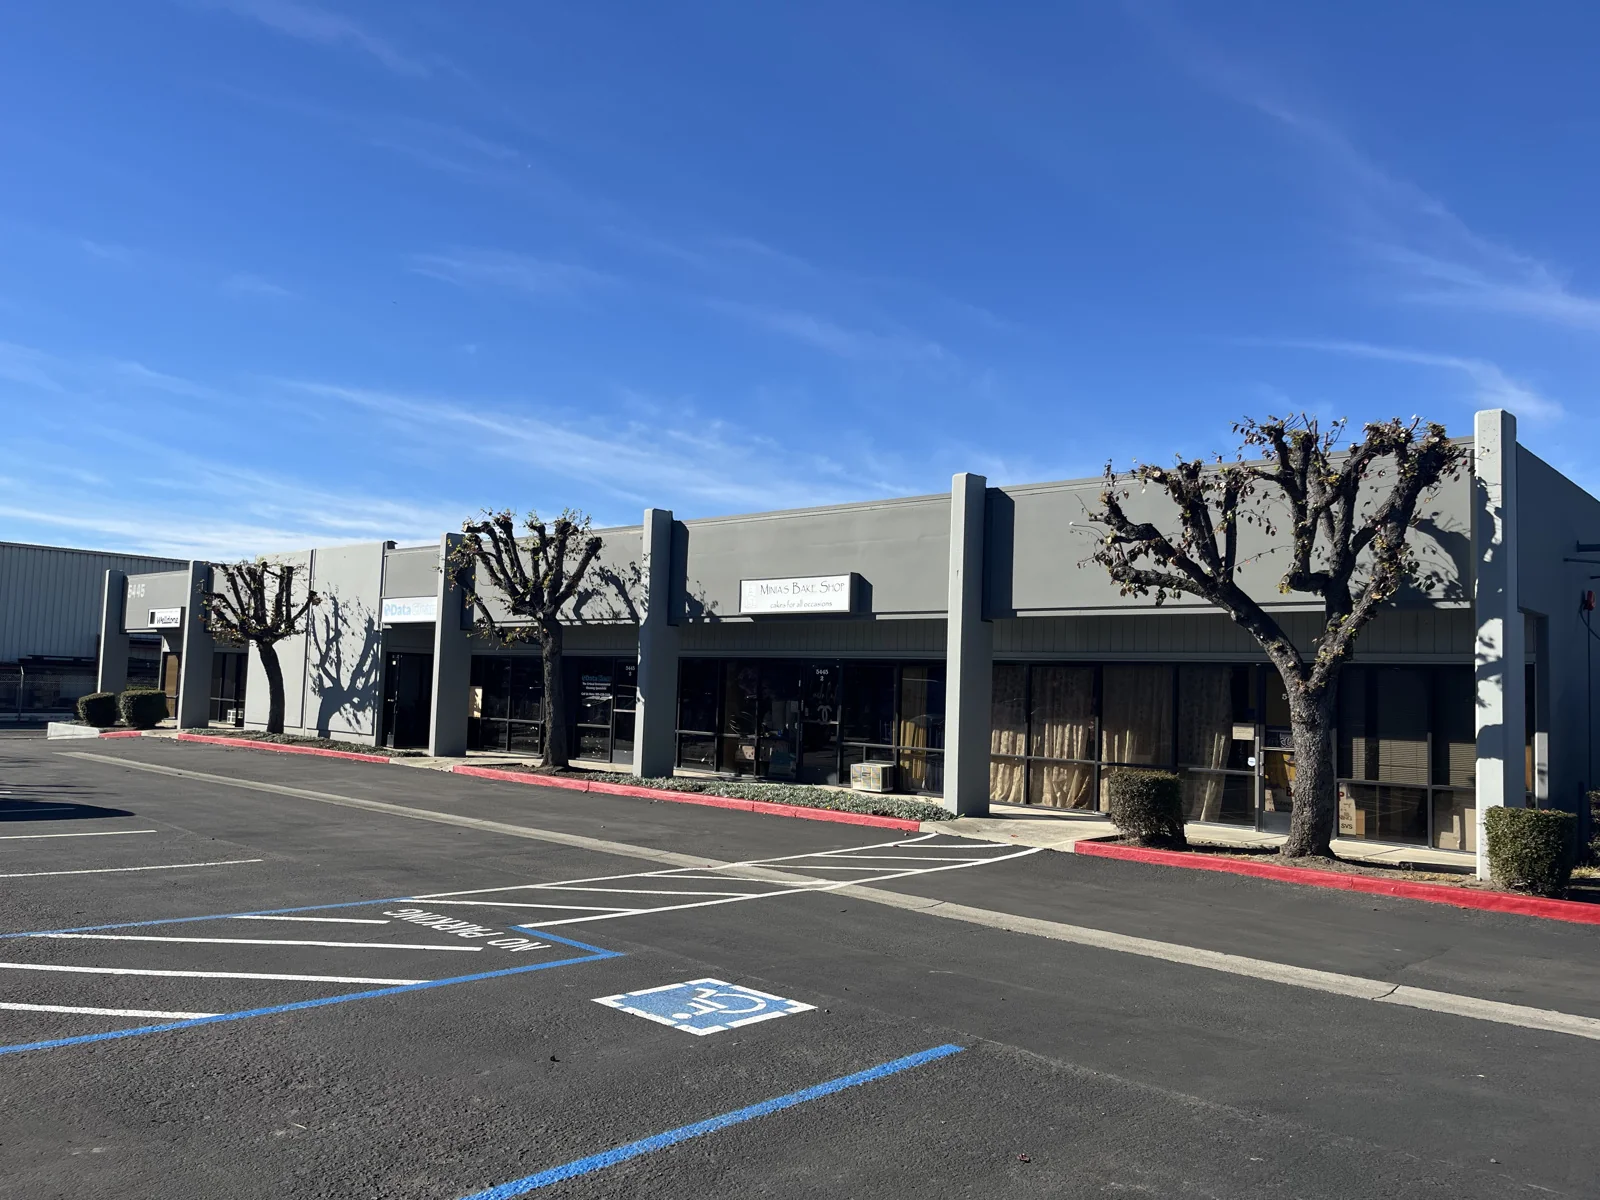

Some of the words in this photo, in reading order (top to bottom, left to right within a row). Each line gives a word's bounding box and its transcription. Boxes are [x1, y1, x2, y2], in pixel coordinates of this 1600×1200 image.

[128, 583, 145, 598] 5445
[819, 581, 845, 593] SHOP
[770, 601, 786, 609] cakes
[787, 600, 795, 609] for
[382, 908, 505, 938] PARKING
[486, 938, 552, 952] NO
